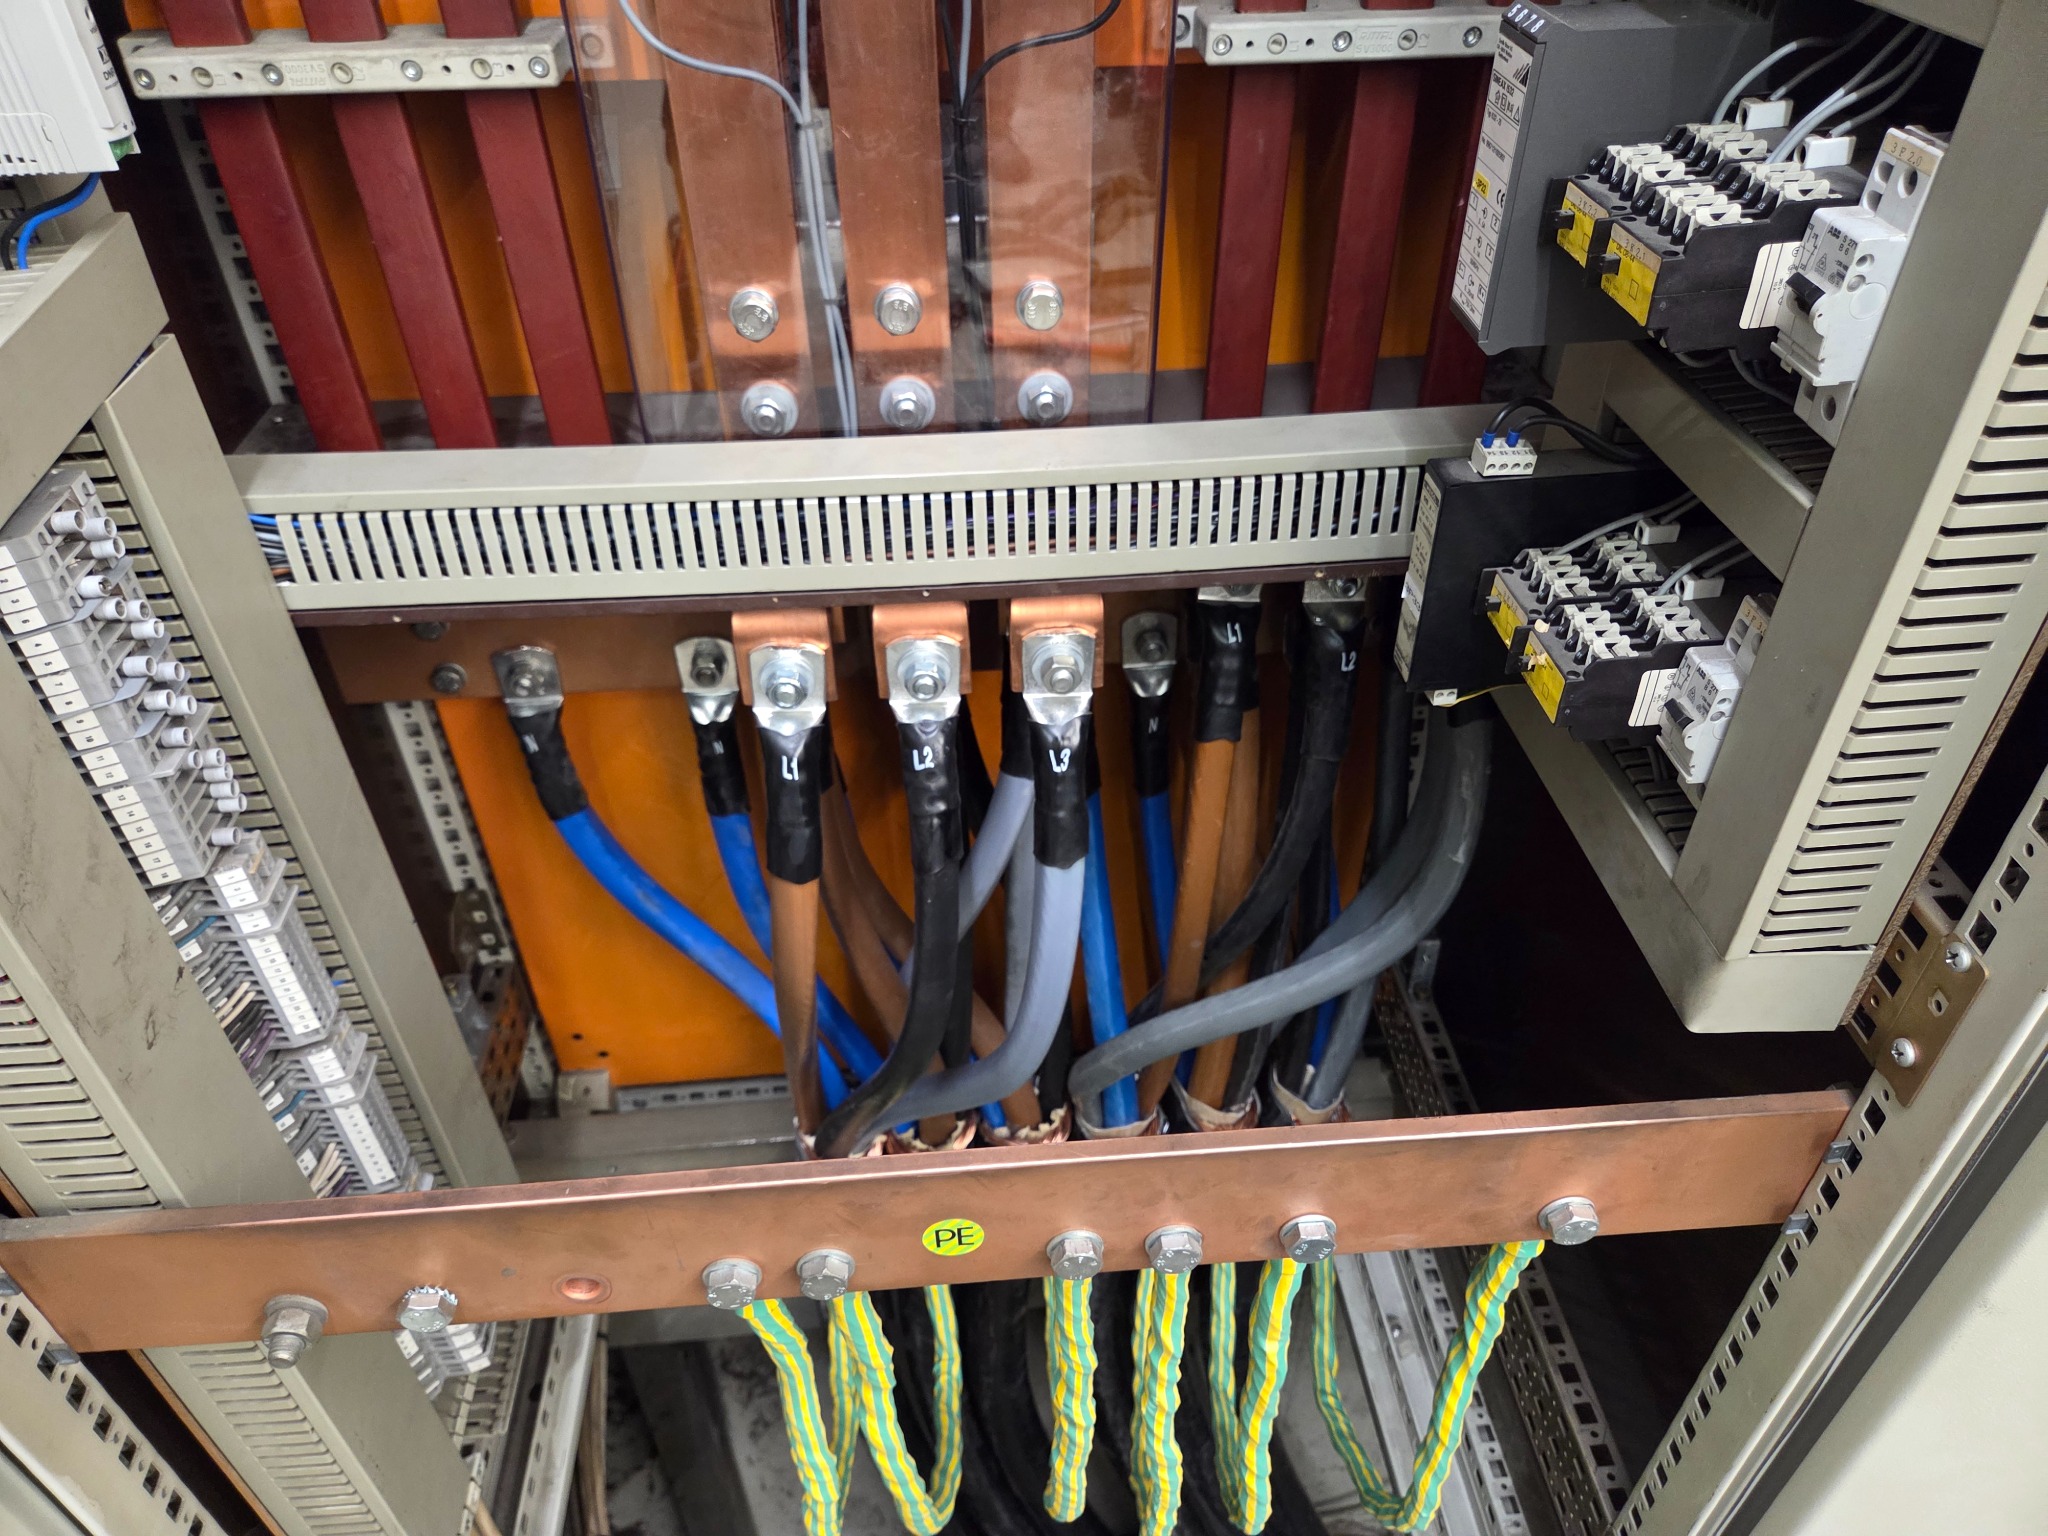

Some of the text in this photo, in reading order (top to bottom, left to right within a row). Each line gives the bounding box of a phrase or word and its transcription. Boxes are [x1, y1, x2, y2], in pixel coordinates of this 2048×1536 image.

[1827, 225, 1841, 239] ABB
[1227, 622, 1242, 644] L1
[1341, 651, 1357, 672] L2
[1148, 717, 1158, 733] N
[522, 734, 539, 753] N
[713, 740, 724, 755] N
[781, 755, 799, 781] L1
[913, 746, 934, 771] L2
[1049, 748, 1071, 773] L3
[934, 1226, 975, 1248] PE
